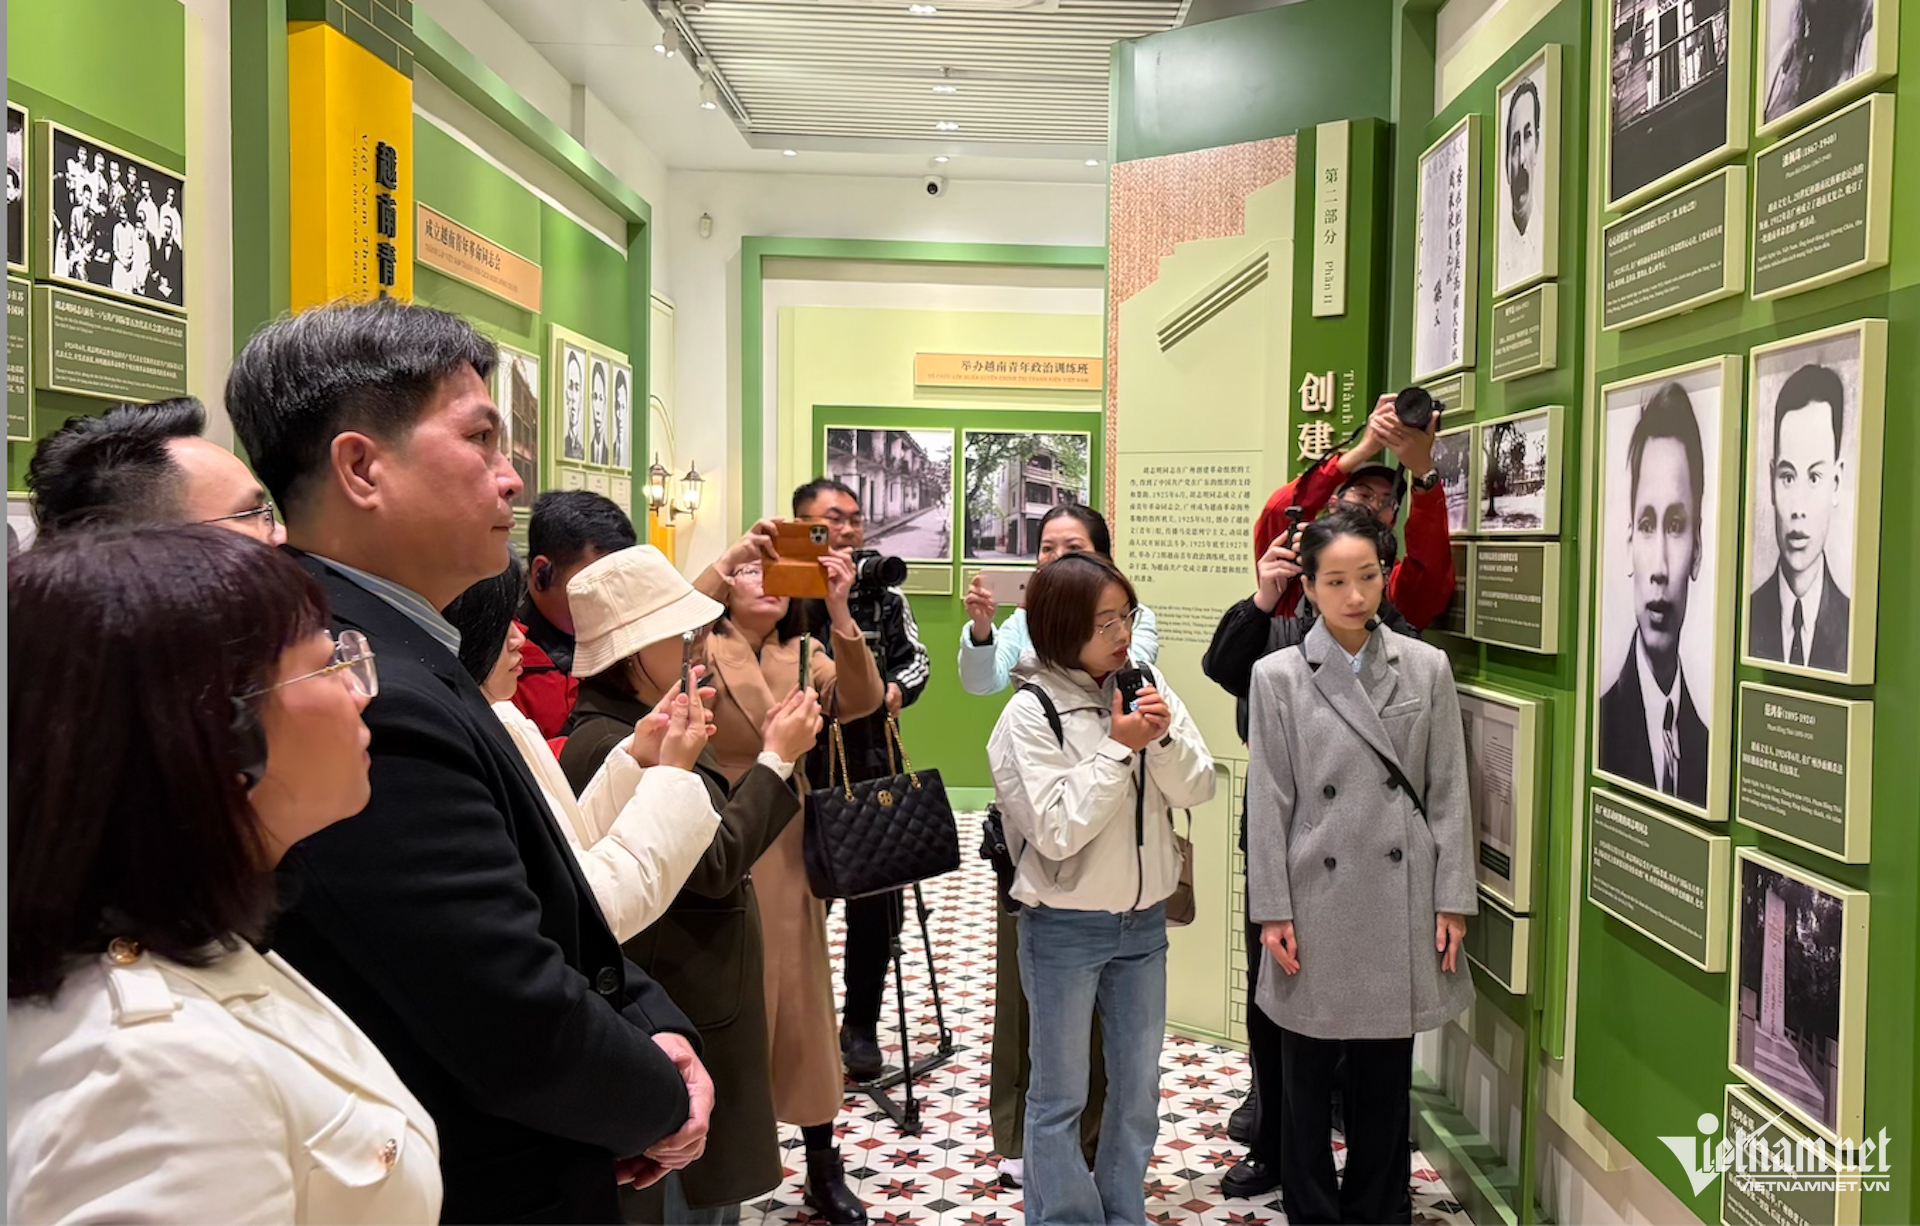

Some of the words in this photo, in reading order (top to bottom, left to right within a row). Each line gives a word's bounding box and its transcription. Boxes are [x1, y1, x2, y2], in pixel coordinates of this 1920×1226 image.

[376, 141, 397, 300] 越南青
[1323, 167, 1339, 245] 第二部分
[961, 360, 1088, 374] 举办越南青年政治训练班
[1298, 371, 1337, 462] 创建
